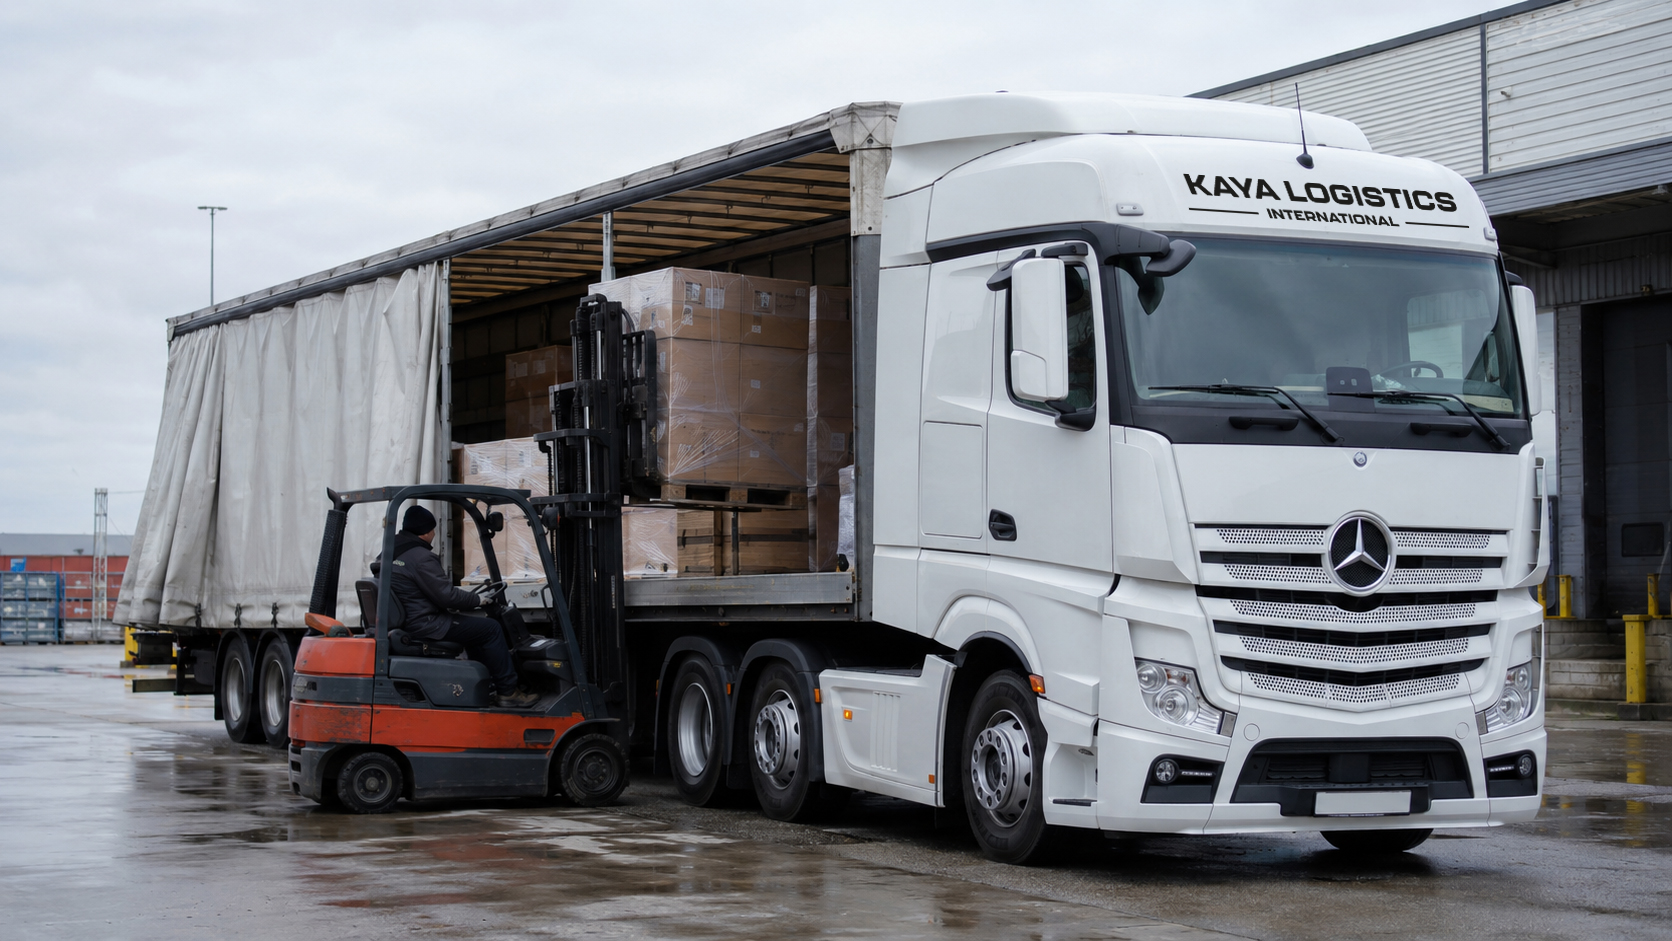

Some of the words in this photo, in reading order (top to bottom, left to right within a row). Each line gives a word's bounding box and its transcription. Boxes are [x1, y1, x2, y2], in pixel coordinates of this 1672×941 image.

[1183, 173, 1281, 201] KAYA
[1283, 180, 1458, 213] LOGISTICS
[1266, 208, 1400, 227] INTERNATIONAL
